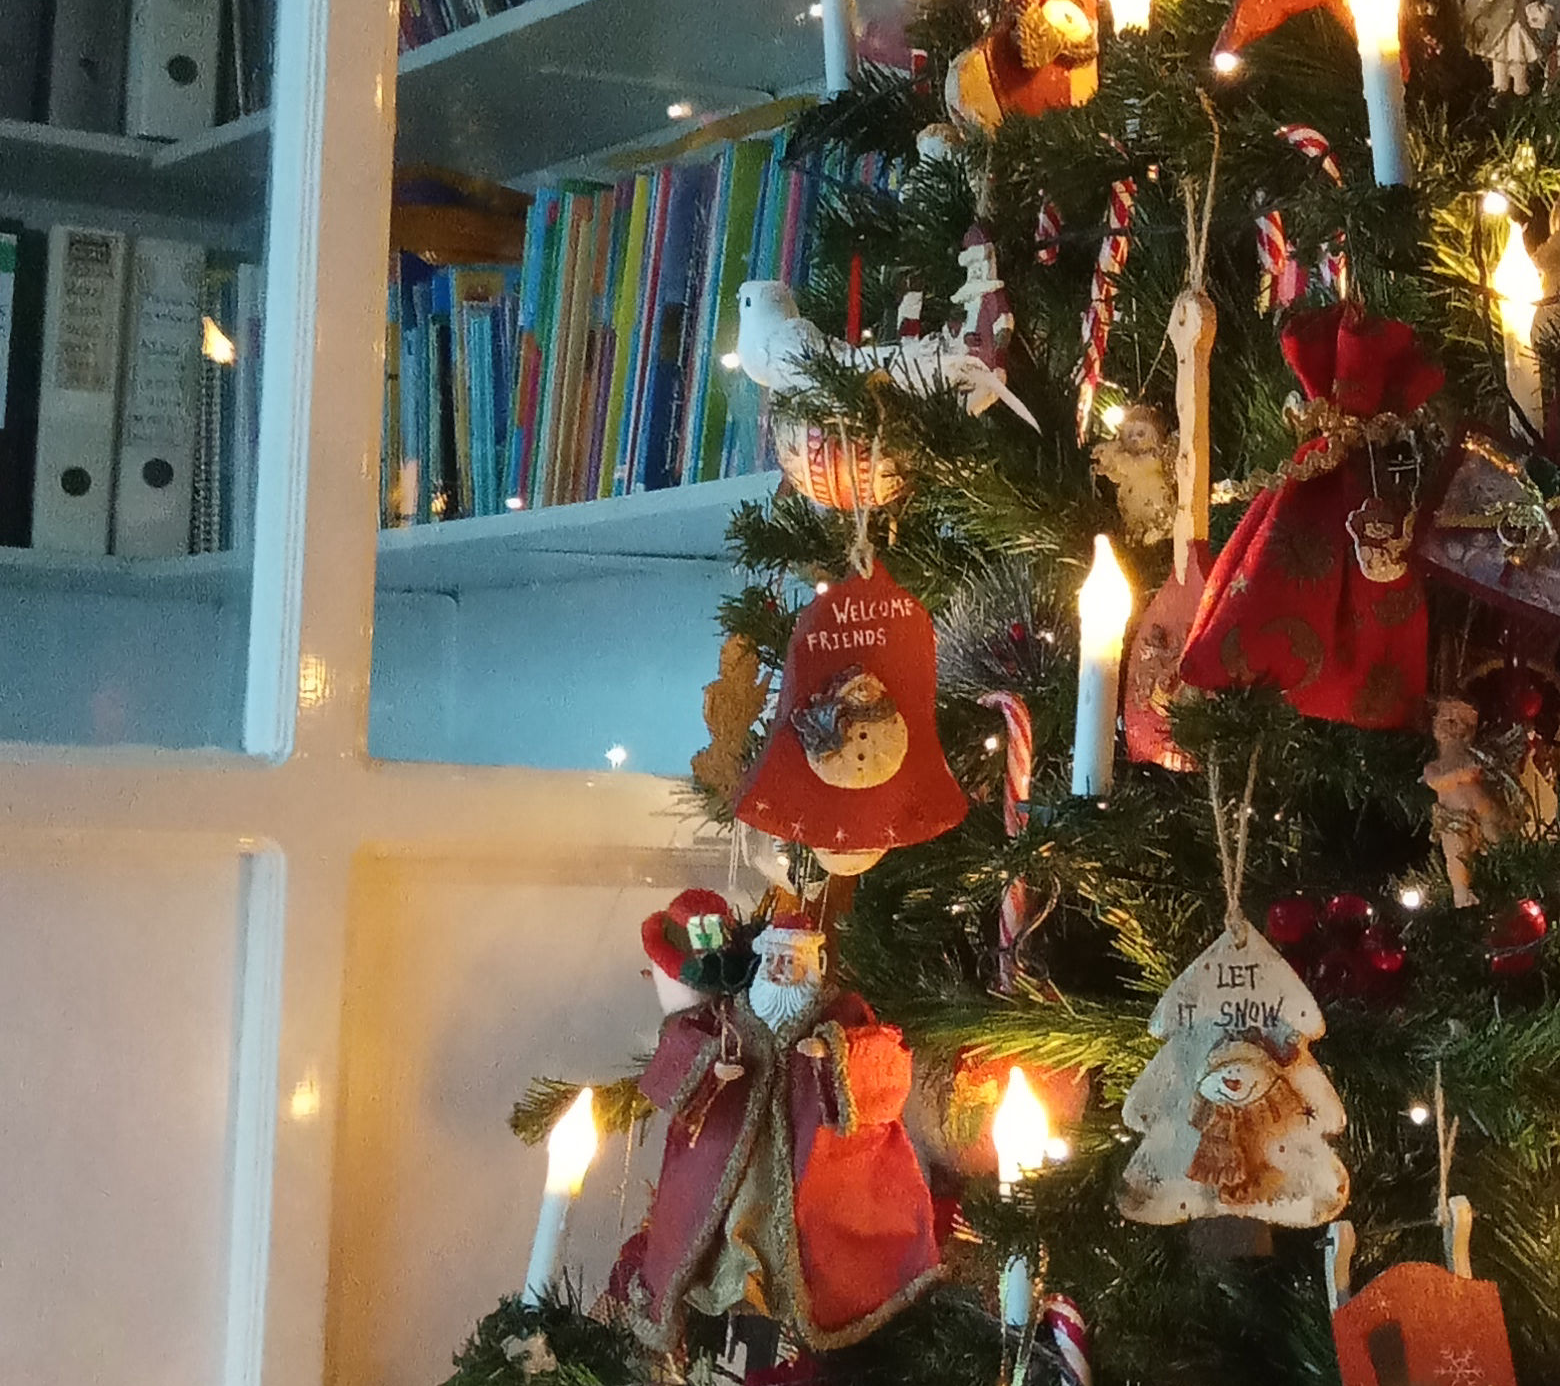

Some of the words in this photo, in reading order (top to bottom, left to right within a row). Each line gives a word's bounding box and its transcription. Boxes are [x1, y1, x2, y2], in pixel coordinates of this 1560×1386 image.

[831, 596, 916, 626] WELCOME
[806, 628, 888, 653] FRIENDS
[1216, 963, 1260, 990] LET
[1177, 1003, 1198, 1031] IT
[1213, 996, 1284, 1029] SNOW
